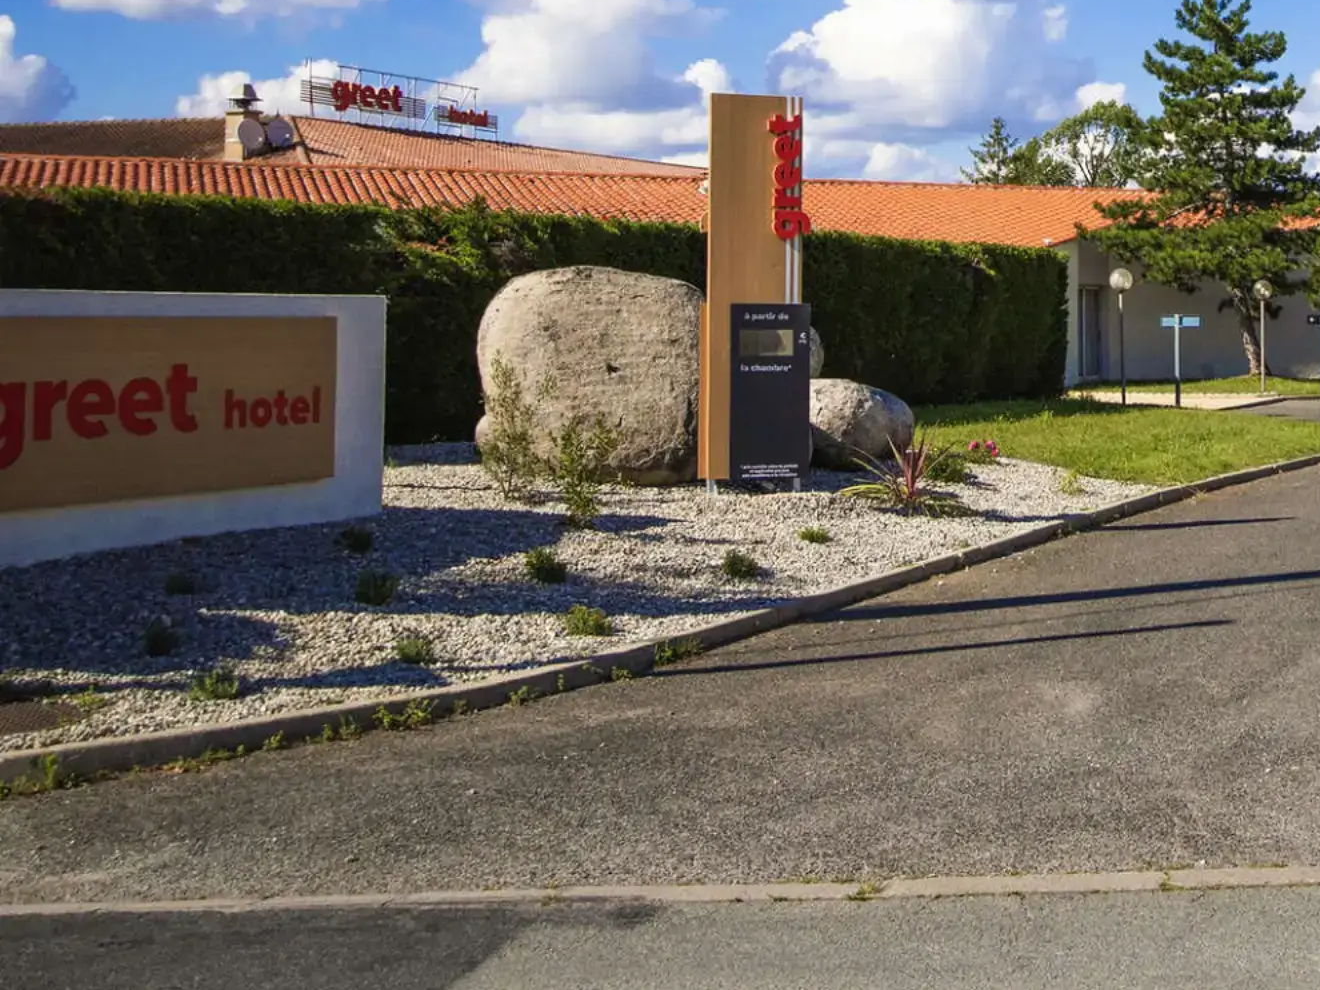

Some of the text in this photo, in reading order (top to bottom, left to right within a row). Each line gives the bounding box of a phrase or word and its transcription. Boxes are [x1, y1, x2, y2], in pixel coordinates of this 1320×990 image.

[331, 78, 403, 112] greet
[767, 113, 811, 241] greet
[751, 312, 776, 321] partir
[777, 312, 790, 320] de
[740, 363, 749, 372] la
[224, 386, 321, 429] hotel
